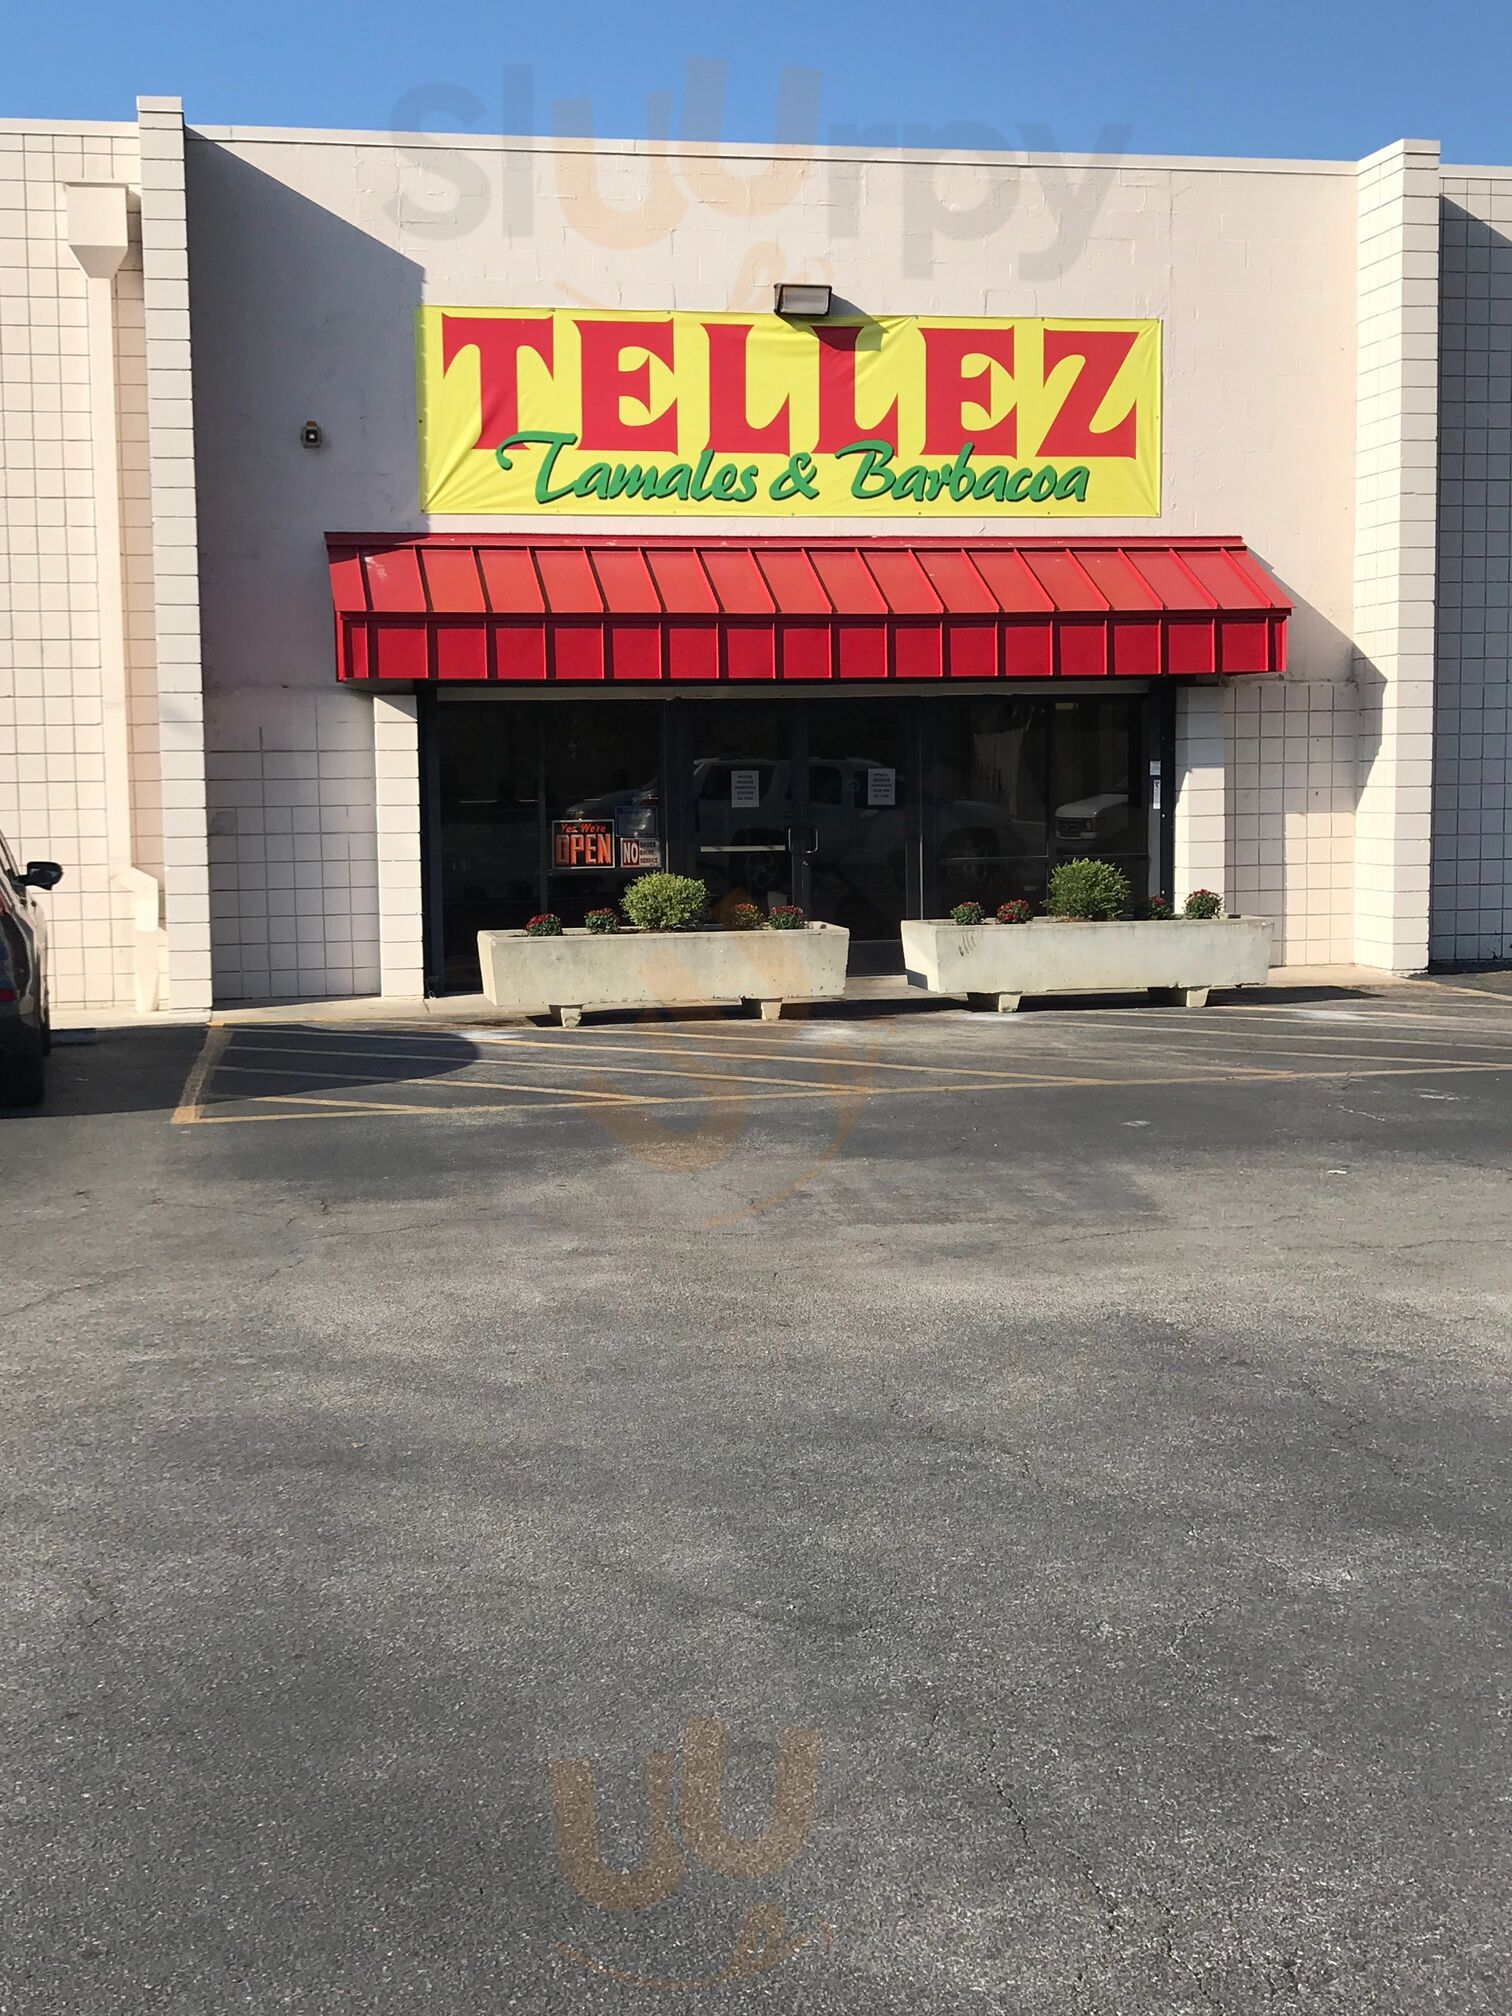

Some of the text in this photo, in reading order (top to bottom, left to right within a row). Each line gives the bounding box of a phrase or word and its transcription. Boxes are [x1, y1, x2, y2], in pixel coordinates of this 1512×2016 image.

[441, 314, 1138, 459] TELLEZ
[497, 430, 1089, 504] Tamales & Barbacoa
[555, 833, 611, 865] OPEN
[623, 842, 639, 864] NO
